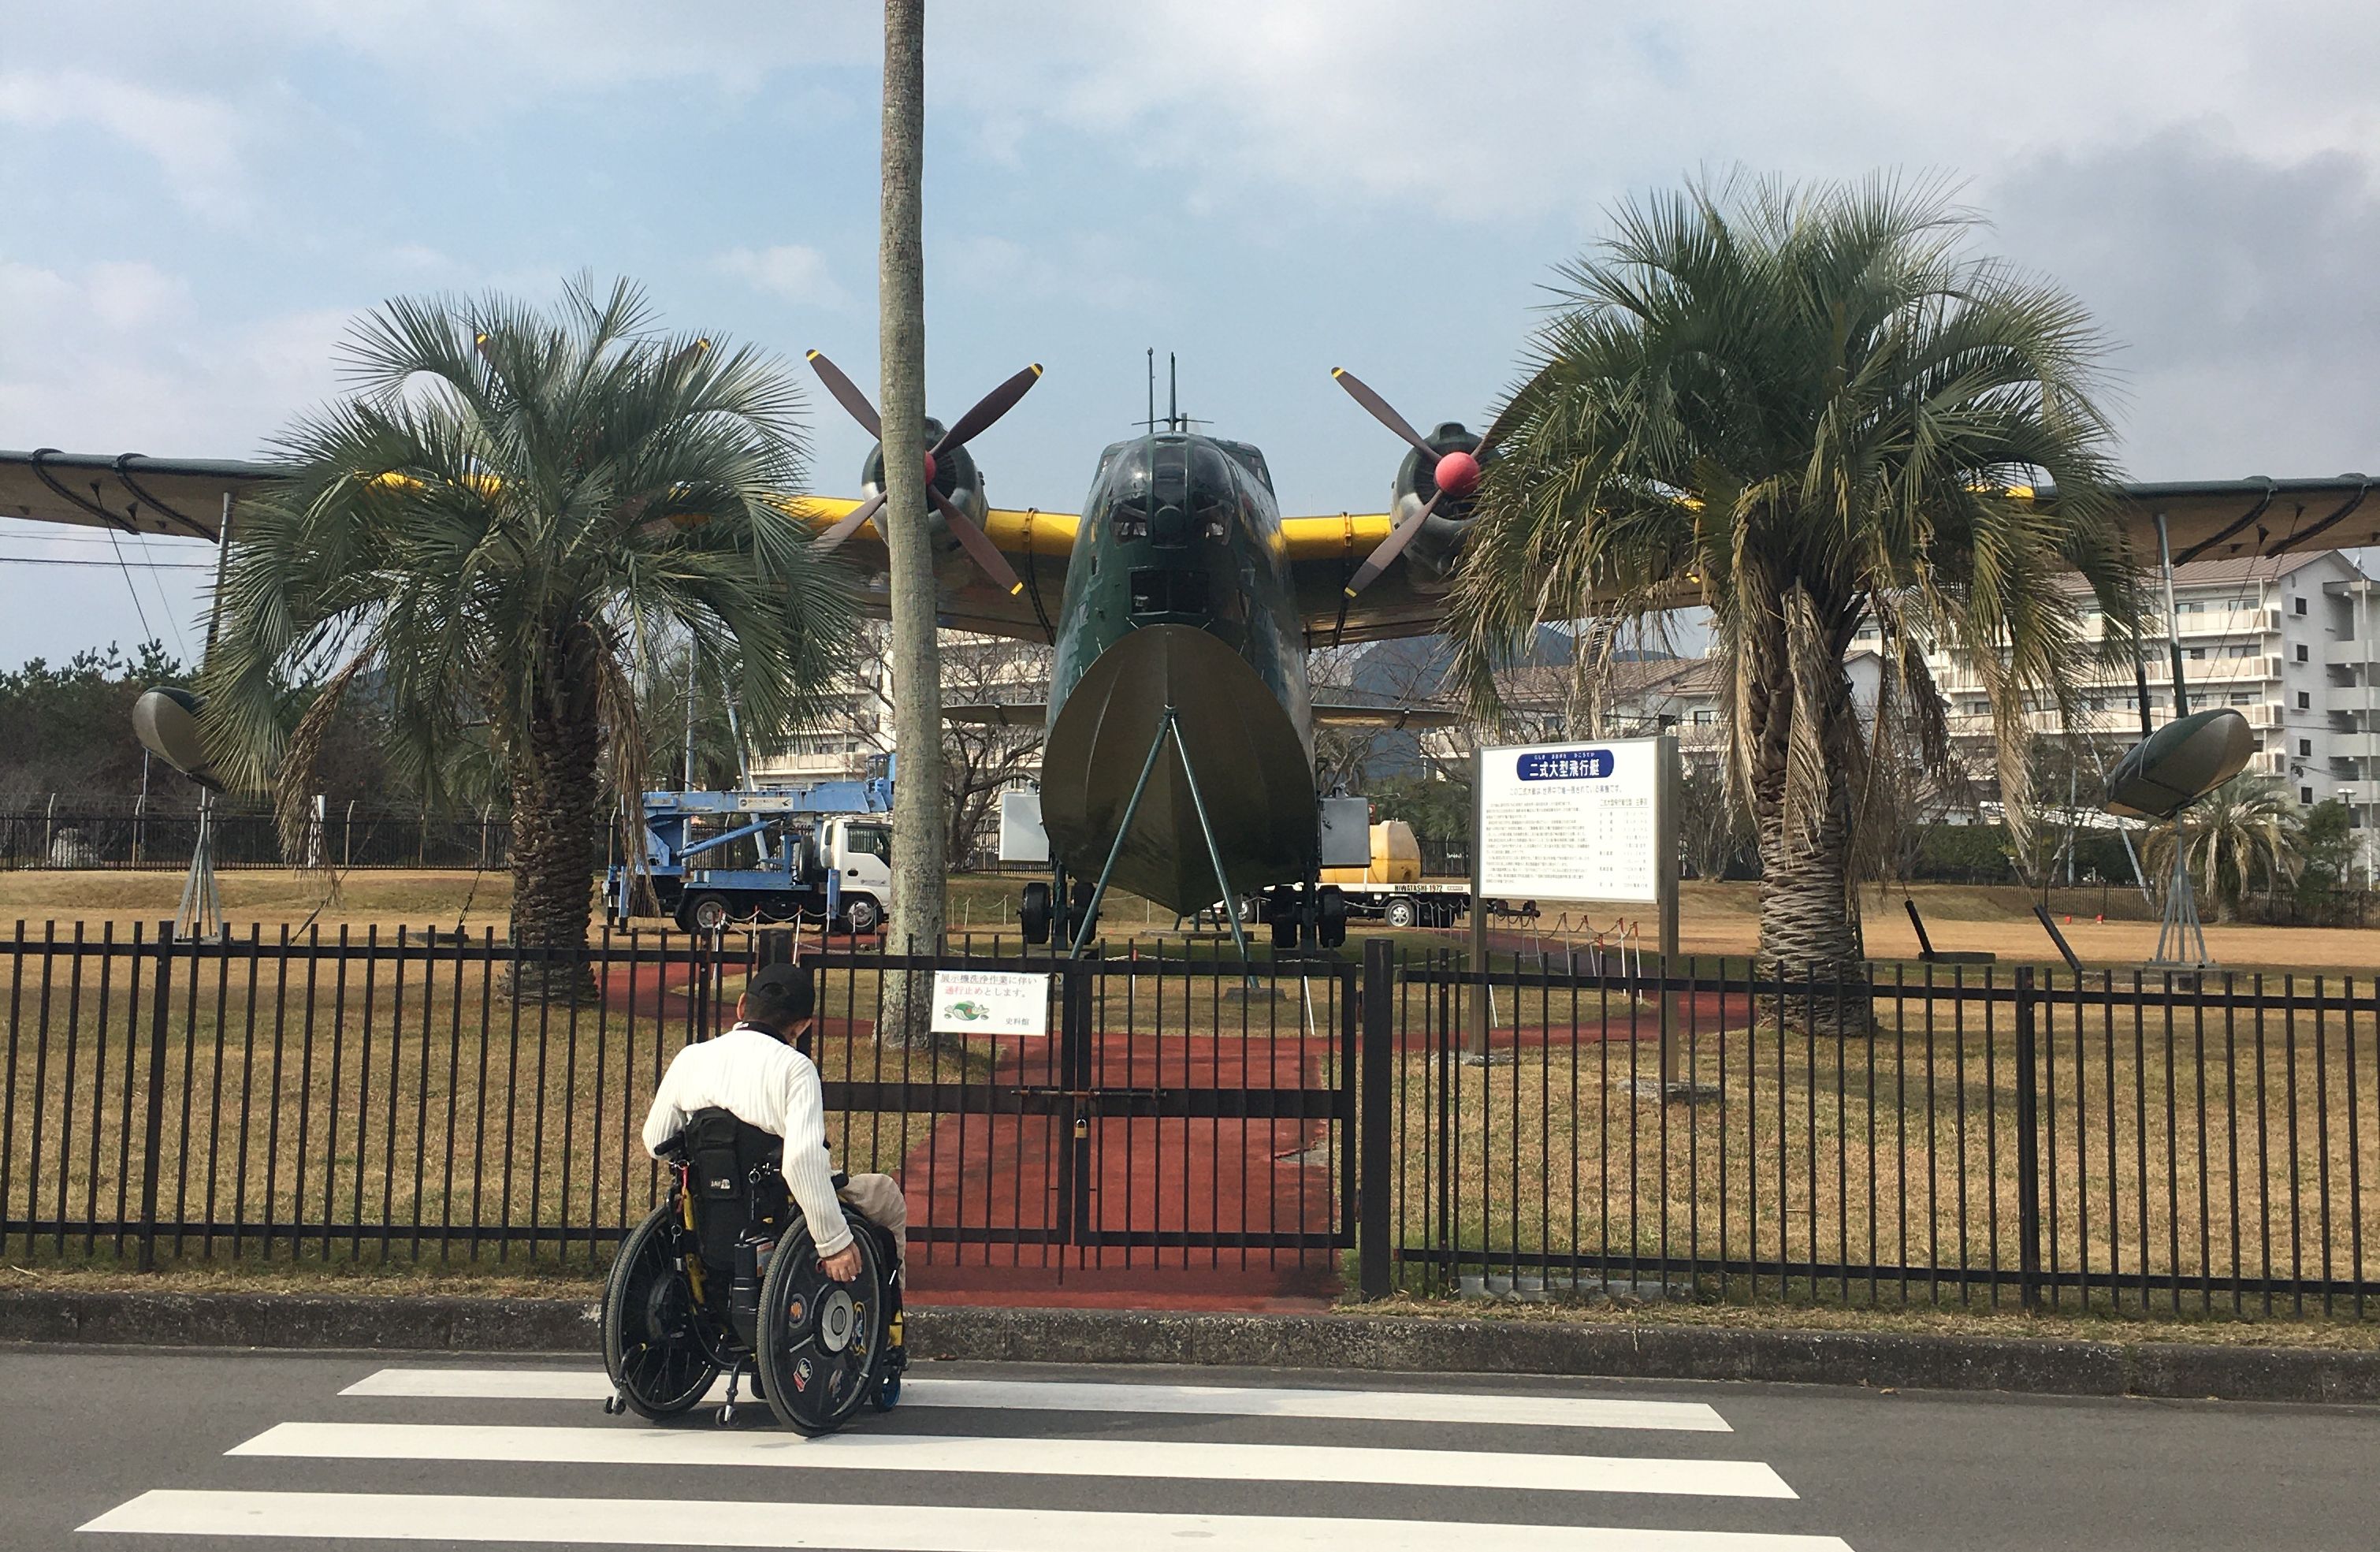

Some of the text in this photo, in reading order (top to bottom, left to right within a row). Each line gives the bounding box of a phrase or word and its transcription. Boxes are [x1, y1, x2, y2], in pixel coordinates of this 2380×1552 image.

[1529, 758, 1600, 778] 二式大型飛行艇
[940, 973, 1037, 985] 展示機洗浄作業に伴い
[945, 985, 1025, 998] 通行止めとします。
[1006, 1018, 1029, 1026] 史料館
